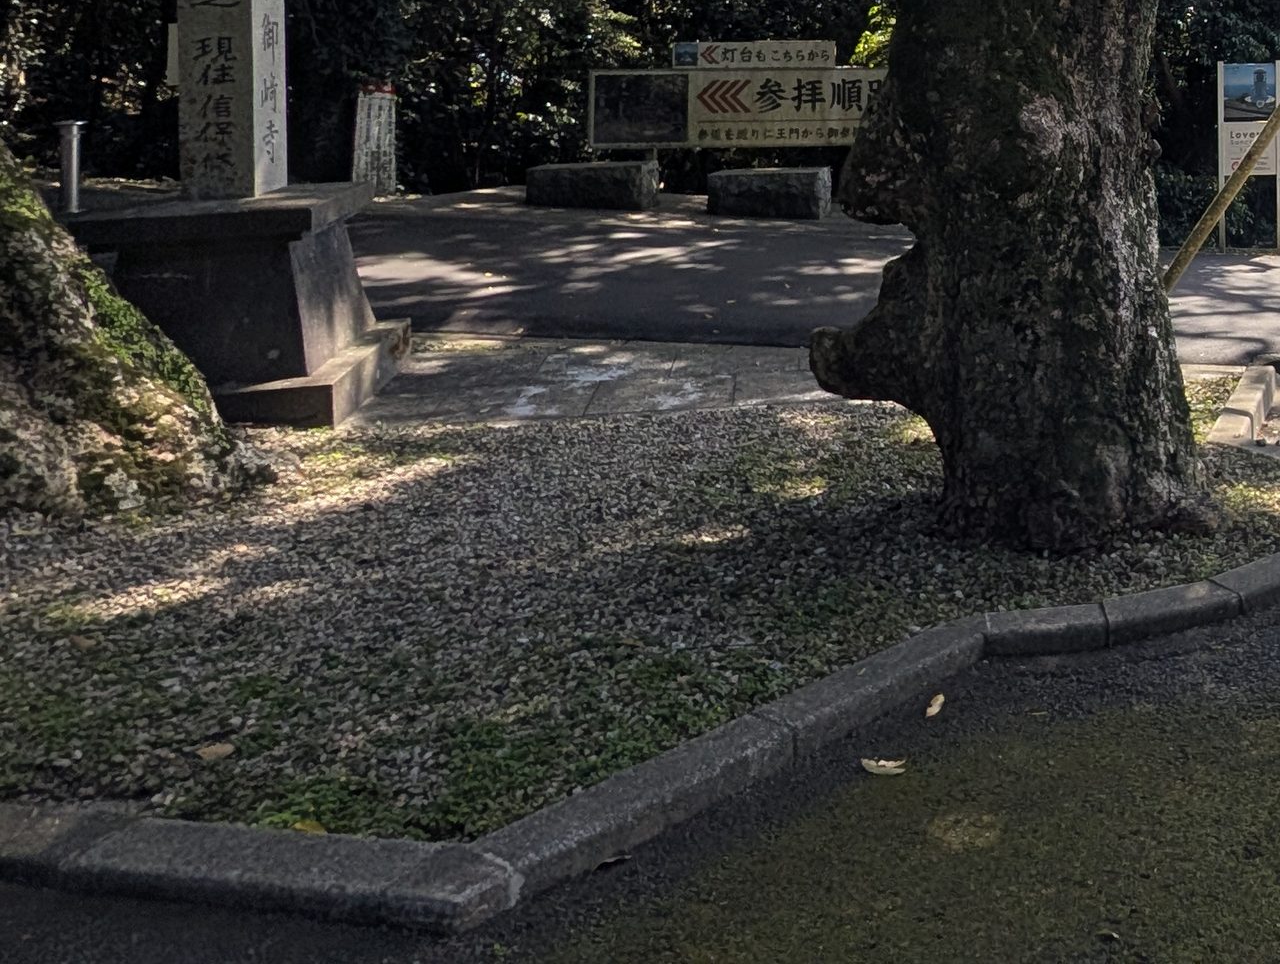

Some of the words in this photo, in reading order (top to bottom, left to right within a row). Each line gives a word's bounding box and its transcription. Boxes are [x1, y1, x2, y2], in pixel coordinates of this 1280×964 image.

[721, 46, 830, 63] 灯台もこちらから
